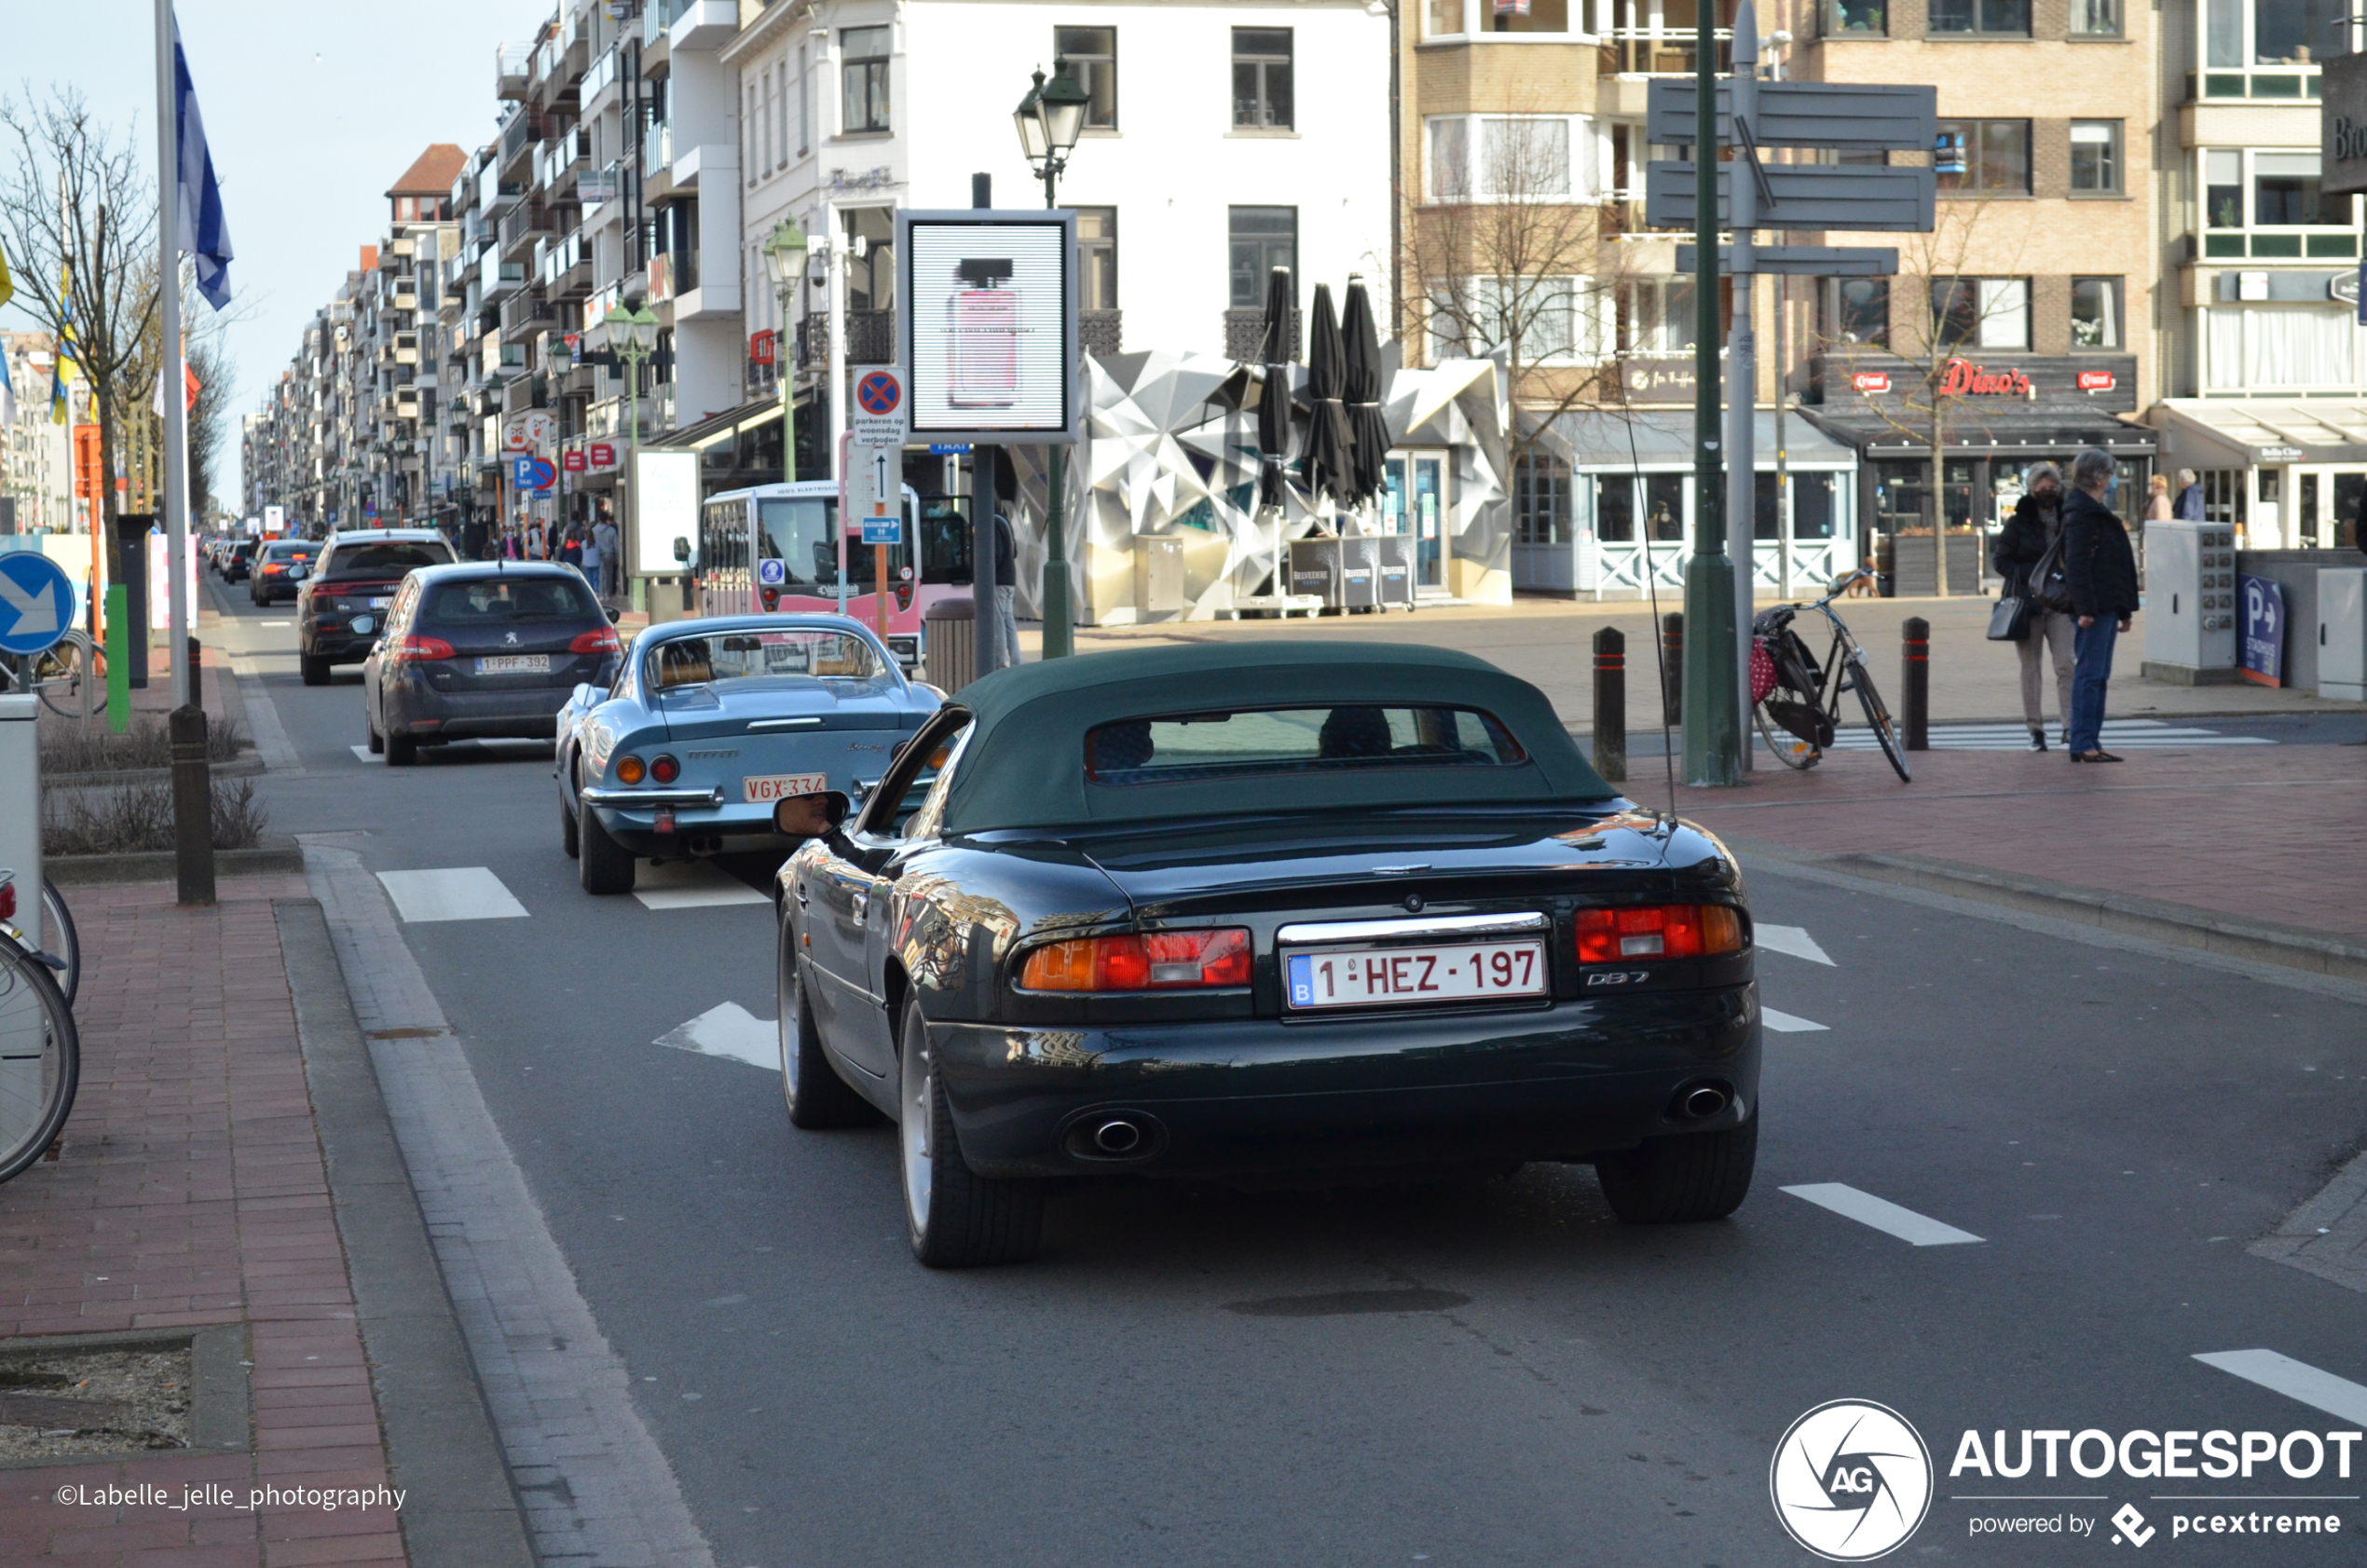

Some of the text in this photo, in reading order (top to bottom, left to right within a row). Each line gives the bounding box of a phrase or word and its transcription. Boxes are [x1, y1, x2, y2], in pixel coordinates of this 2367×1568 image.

[1940, 358, 2030, 394] Dino's
[855, 417, 892, 426] parkeren
[859, 427, 901, 436] woensdag
[1293, 570, 1327, 579] BELVEDERE
[484, 656, 548, 669] 1-PPF-392
[1320, 949, 1536, 997] 1-HEZ-197
[1587, 972, 1650, 986] DB7
[1296, 985, 1309, 1001] B
